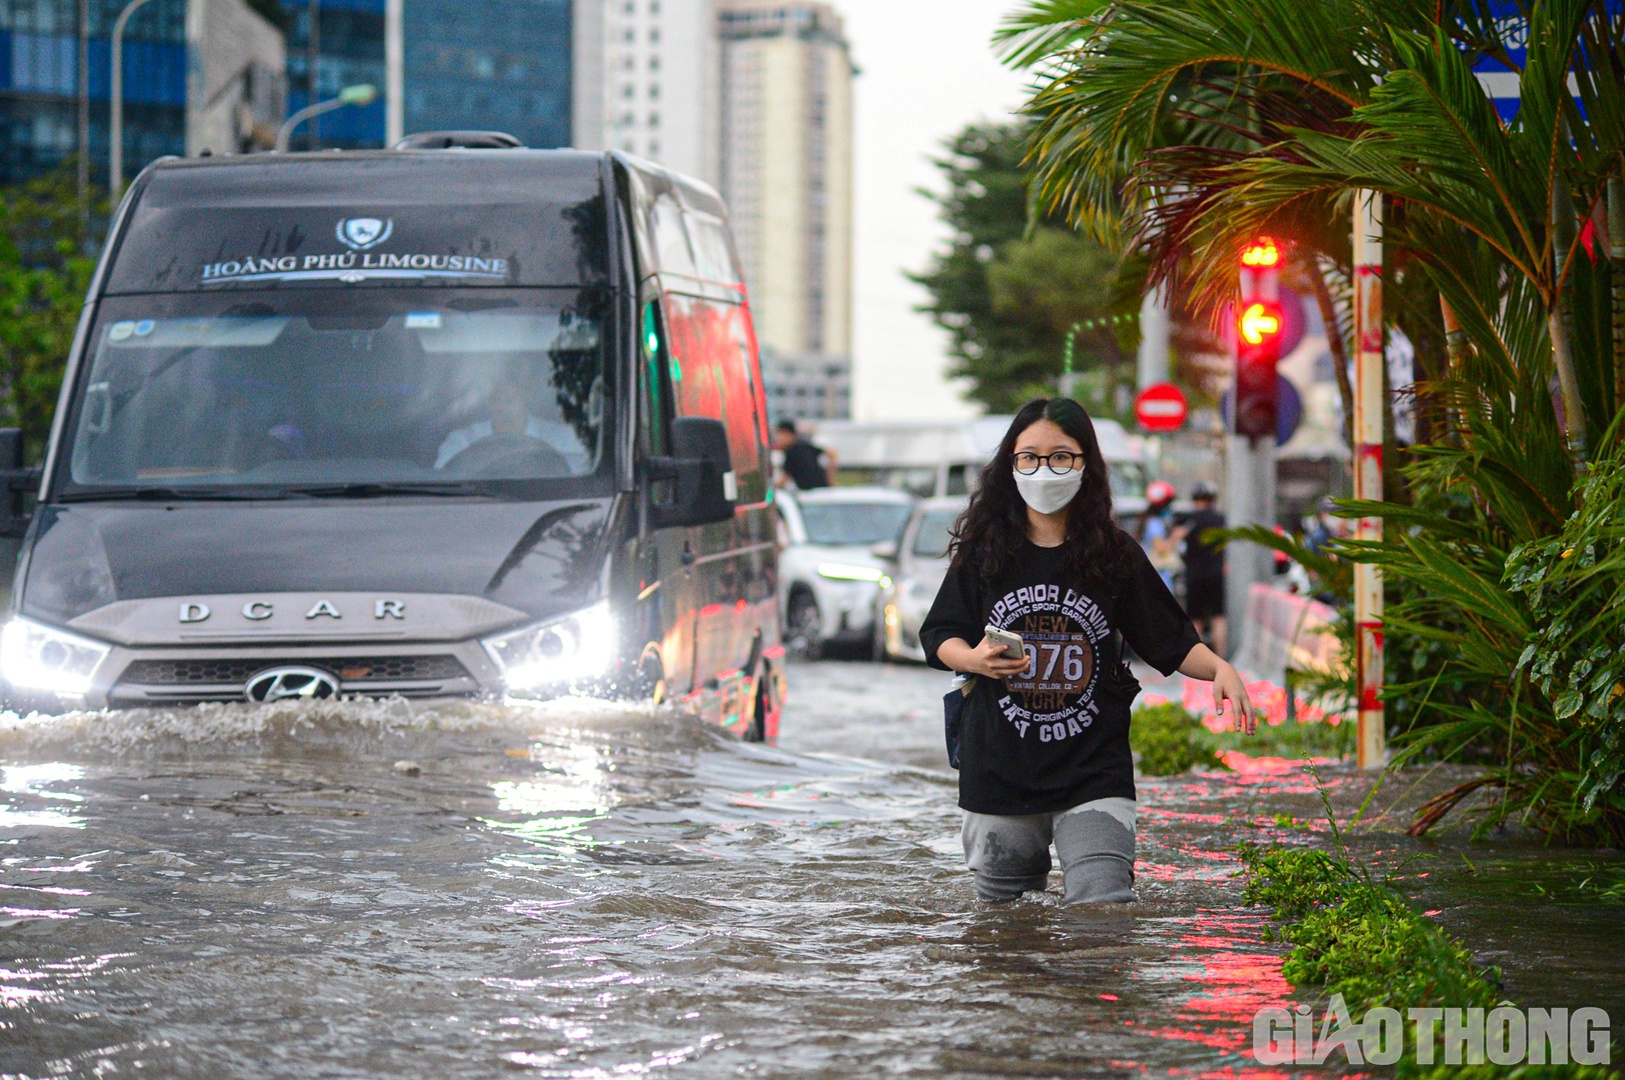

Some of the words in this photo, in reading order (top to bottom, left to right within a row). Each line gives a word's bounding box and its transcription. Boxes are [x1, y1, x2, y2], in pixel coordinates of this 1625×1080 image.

[362, 253, 508, 273] LIMOUSINE
[988, 584, 1060, 628] UPERIOR
[1062, 588, 1111, 640] DENIM
[1000, 605, 1032, 631] THENTIC
[1032, 602, 1061, 613] SPORT
[1061, 607, 1097, 644] GARMENTS
[1025, 615, 1069, 633] NEW
[1021, 690, 1067, 710] YORK
[1033, 706, 1078, 722] ORIGINAL
[1076, 679, 1098, 707] TEAM
[1039, 700, 1100, 743] COAST
